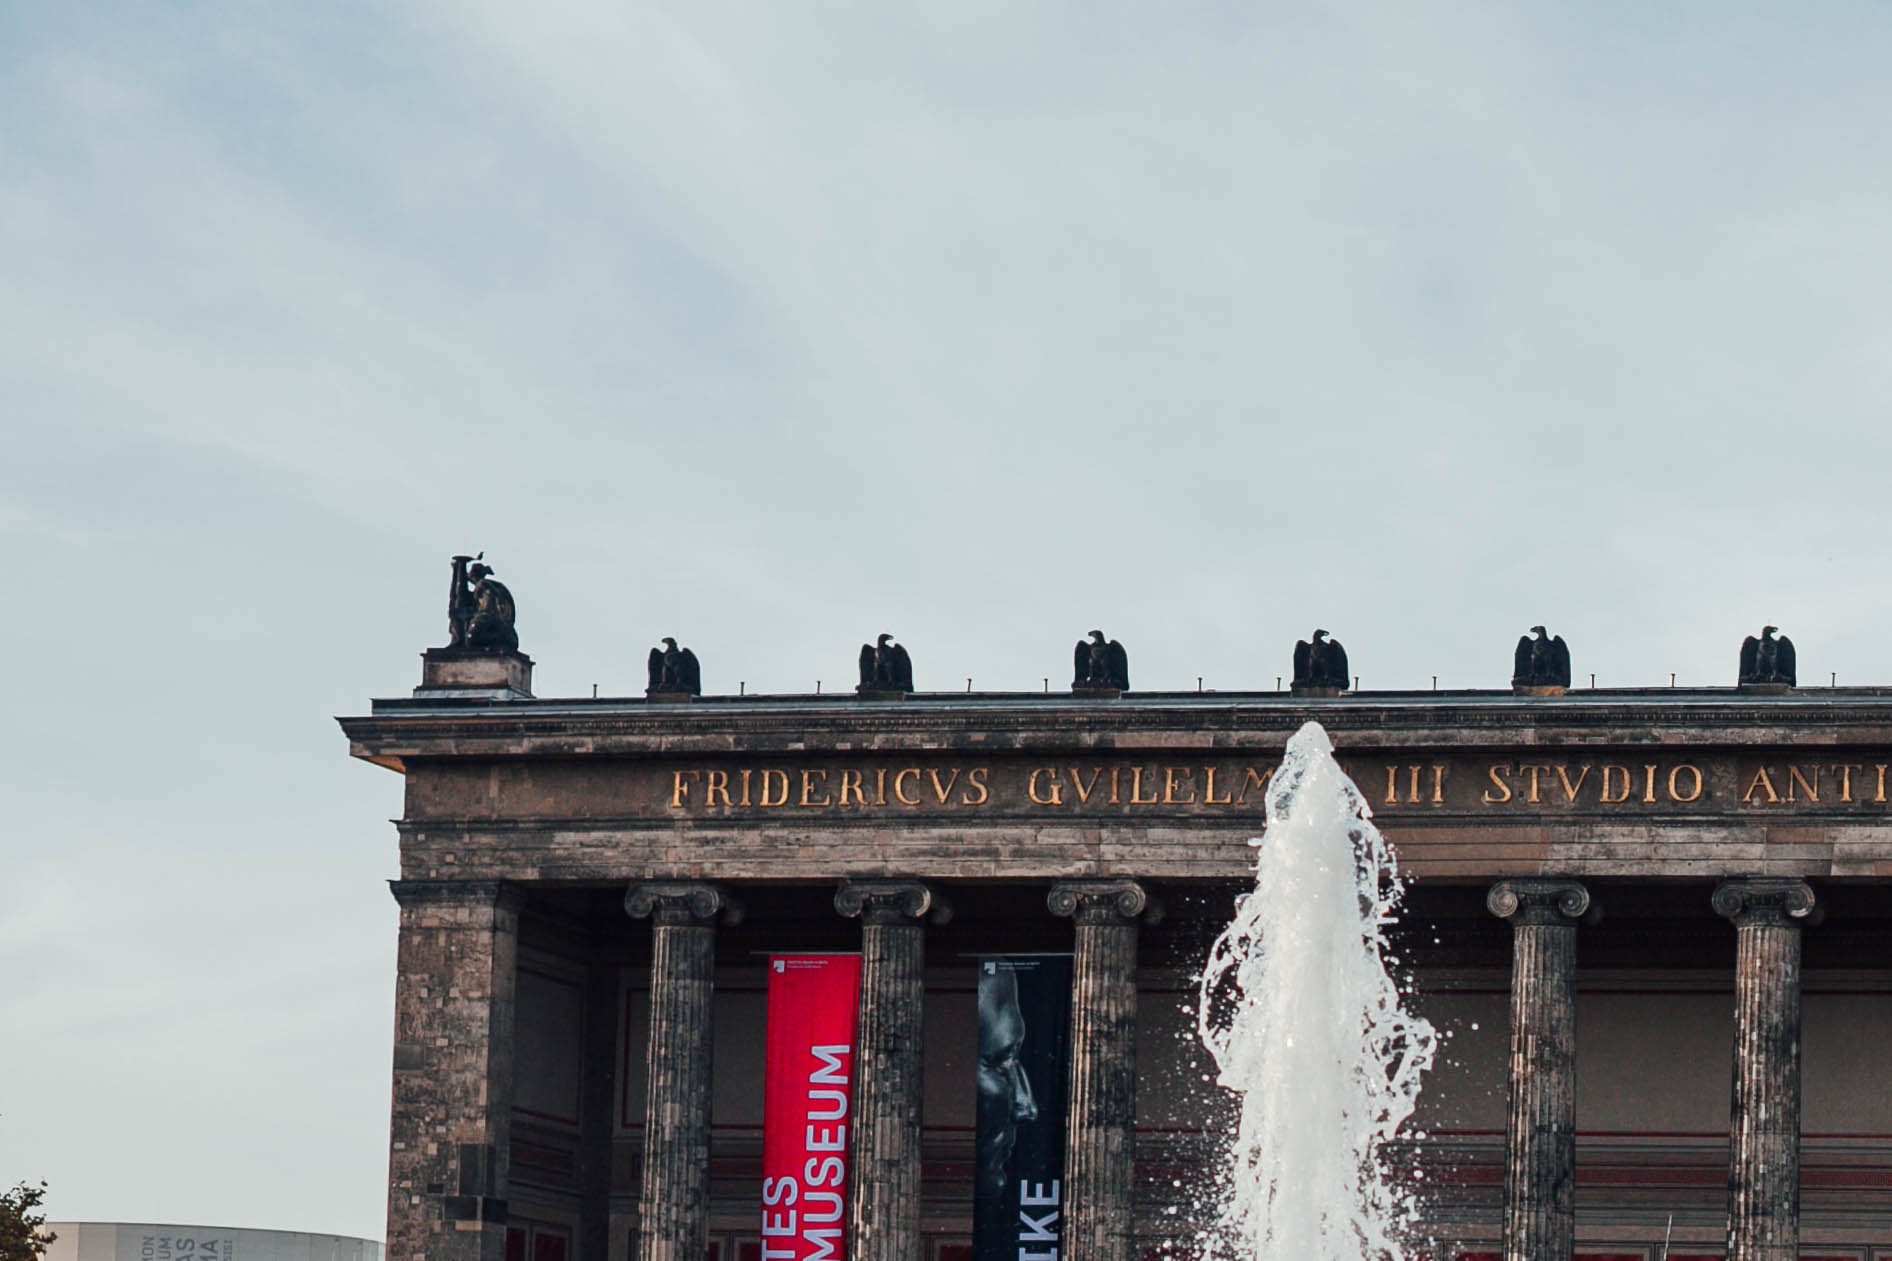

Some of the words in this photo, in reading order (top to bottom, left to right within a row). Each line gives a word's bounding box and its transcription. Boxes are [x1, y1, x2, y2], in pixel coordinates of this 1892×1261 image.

[670, 767, 989, 808] FRIDERICVS
[1027, 766, 1349, 806] GVILELM
[1384, 764, 1444, 804] III
[1483, 764, 1703, 804] STVDIO
